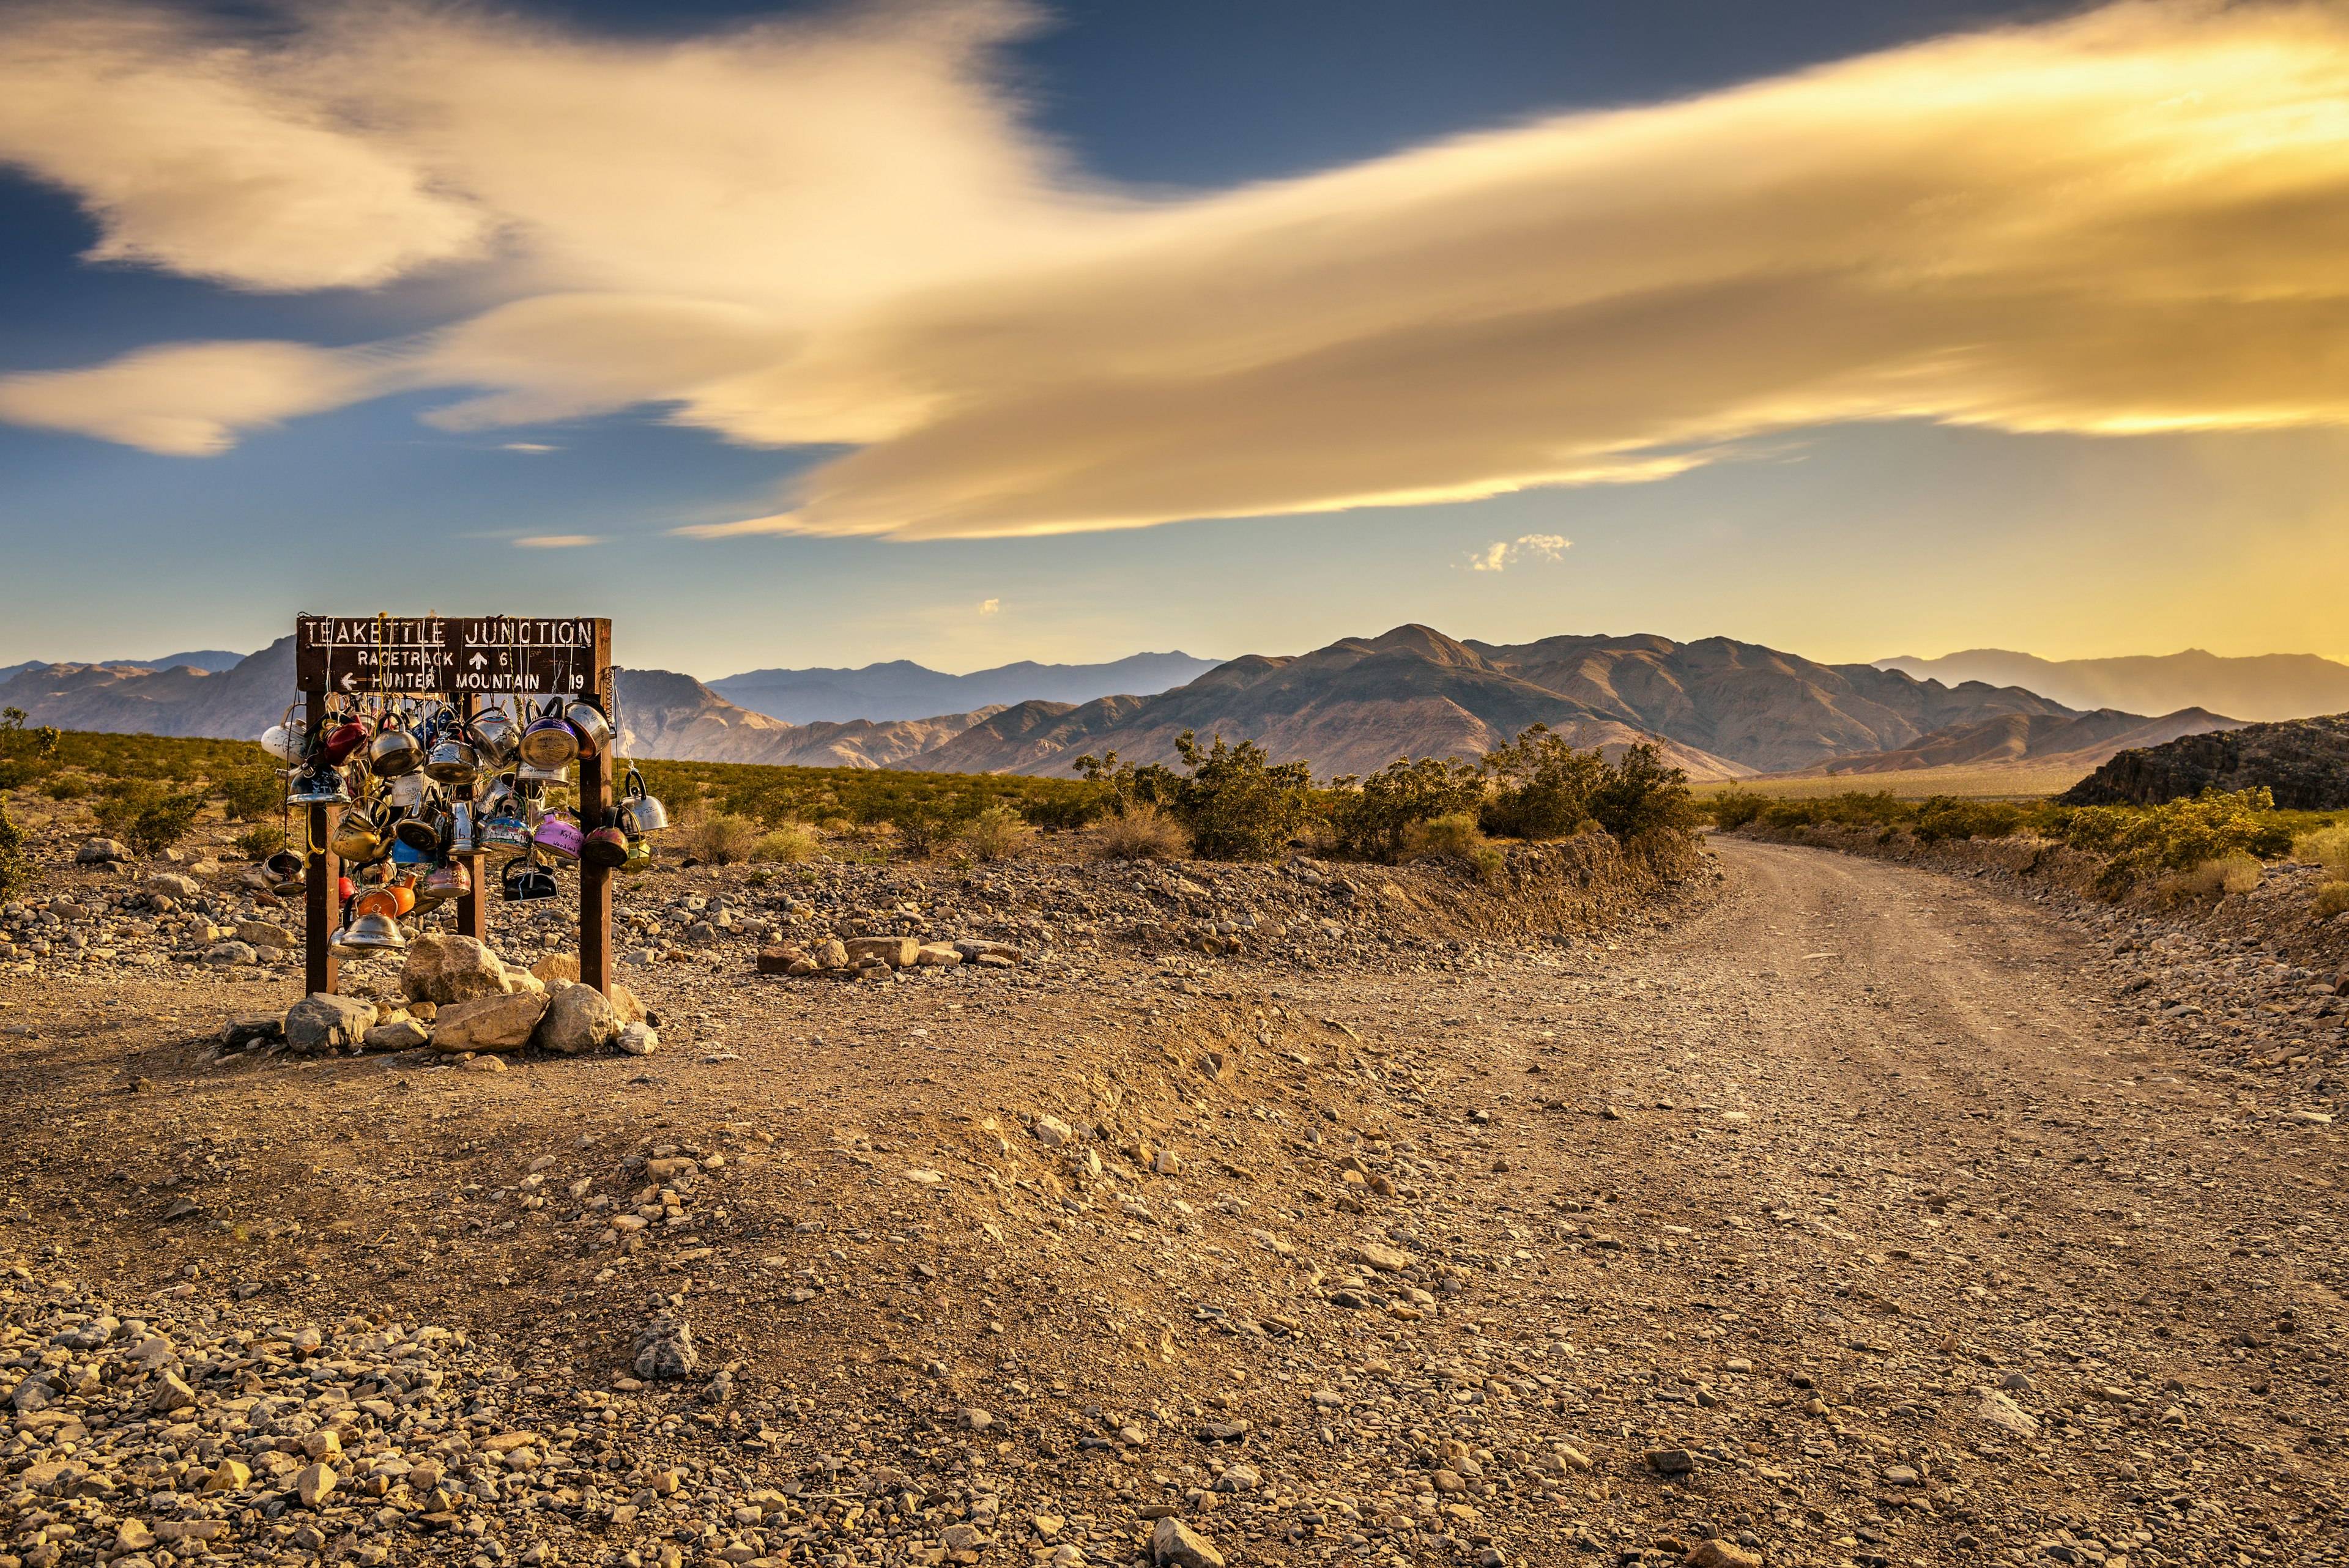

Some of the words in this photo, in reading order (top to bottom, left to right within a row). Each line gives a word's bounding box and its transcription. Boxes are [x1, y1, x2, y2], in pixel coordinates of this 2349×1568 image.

[306, 622, 445, 643] TEAKETTLE
[466, 622, 591, 643] JUNCTION
[358, 651, 453, 666] RACETRACK
[500, 653, 508, 666] 6
[372, 673, 435, 688] HUNTER
[456, 673, 540, 689] MOUNTAIN
[571, 675, 584, 689] 19
[553, 841, 576, 852] Woodland
